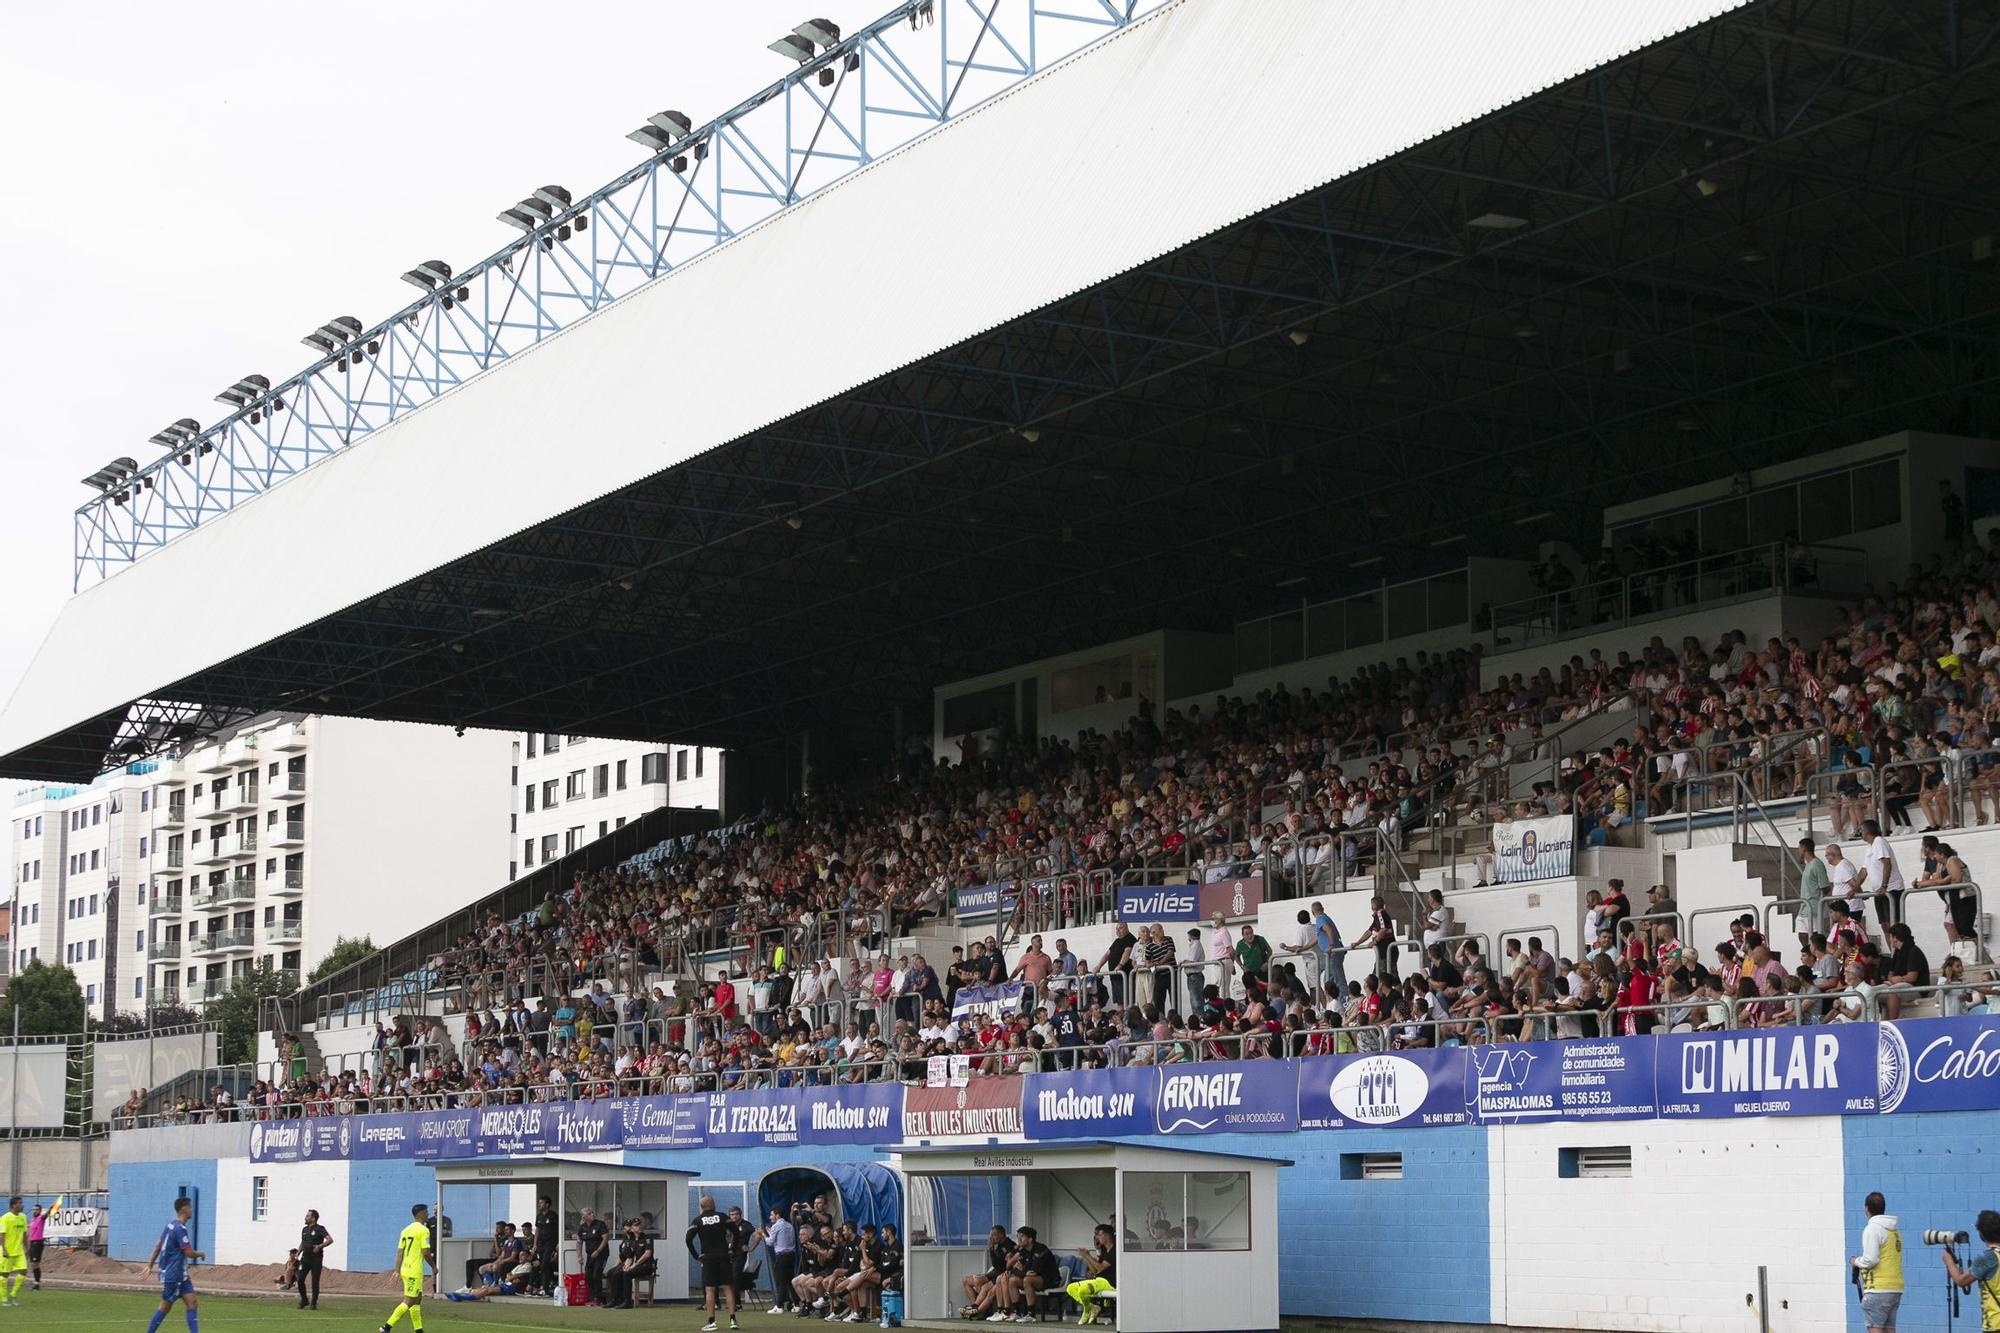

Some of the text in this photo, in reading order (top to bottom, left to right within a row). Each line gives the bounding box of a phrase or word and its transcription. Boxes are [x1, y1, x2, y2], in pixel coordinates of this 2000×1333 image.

[1122, 892, 1195, 914] avilés
[1060, 1020, 1073, 1034] 30
[1562, 1043, 1620, 1058] Administración
[1562, 1056, 1625, 1070] de comunidades
[1722, 1033, 1839, 1093] MILAR
[1561, 1072, 1606, 1086] Inmobiliaria
[1163, 1072, 1243, 1112] ARNAIZ
[1482, 1081, 1512, 1094] agencia
[709, 1094, 726, 1107] BAR
[1039, 1087, 1135, 1121] Mahou SIN
[1481, 1094, 1553, 1111] MASPALOMAS
[1562, 1091, 1612, 1105] 985 56 55 23
[1845, 1095, 1875, 1110] AVILÉS
[642, 1103, 674, 1127] Gema
[812, 1100, 890, 1130] Mahou SIN
[1355, 1106, 1366, 1118] LA
[1562, 1105, 1653, 1117] www.agenciamaspalomas.com
[1692, 1104, 1700, 1112] 28
[480, 1107, 542, 1138] MERCASOLES
[708, 1104, 797, 1134] LA TERRAZA
[906, 1107, 1020, 1135] REAL AVILES INDUSTRIAL
[1225, 1111, 1286, 1124] CLÍNICA PODOLÓGICA
[1422, 1114, 1432, 1124] Tel.
[1433, 1114, 1443, 1123] 641
[1454, 1112, 1465, 1122] 281
[445, 1118, 471, 1138] SPORT
[557, 1112, 605, 1144] Héctor
[263, 1122, 300, 1153] pintavi
[974, 1156, 986, 1167] Real
[1006, 1155, 1034, 1167] Industrial
